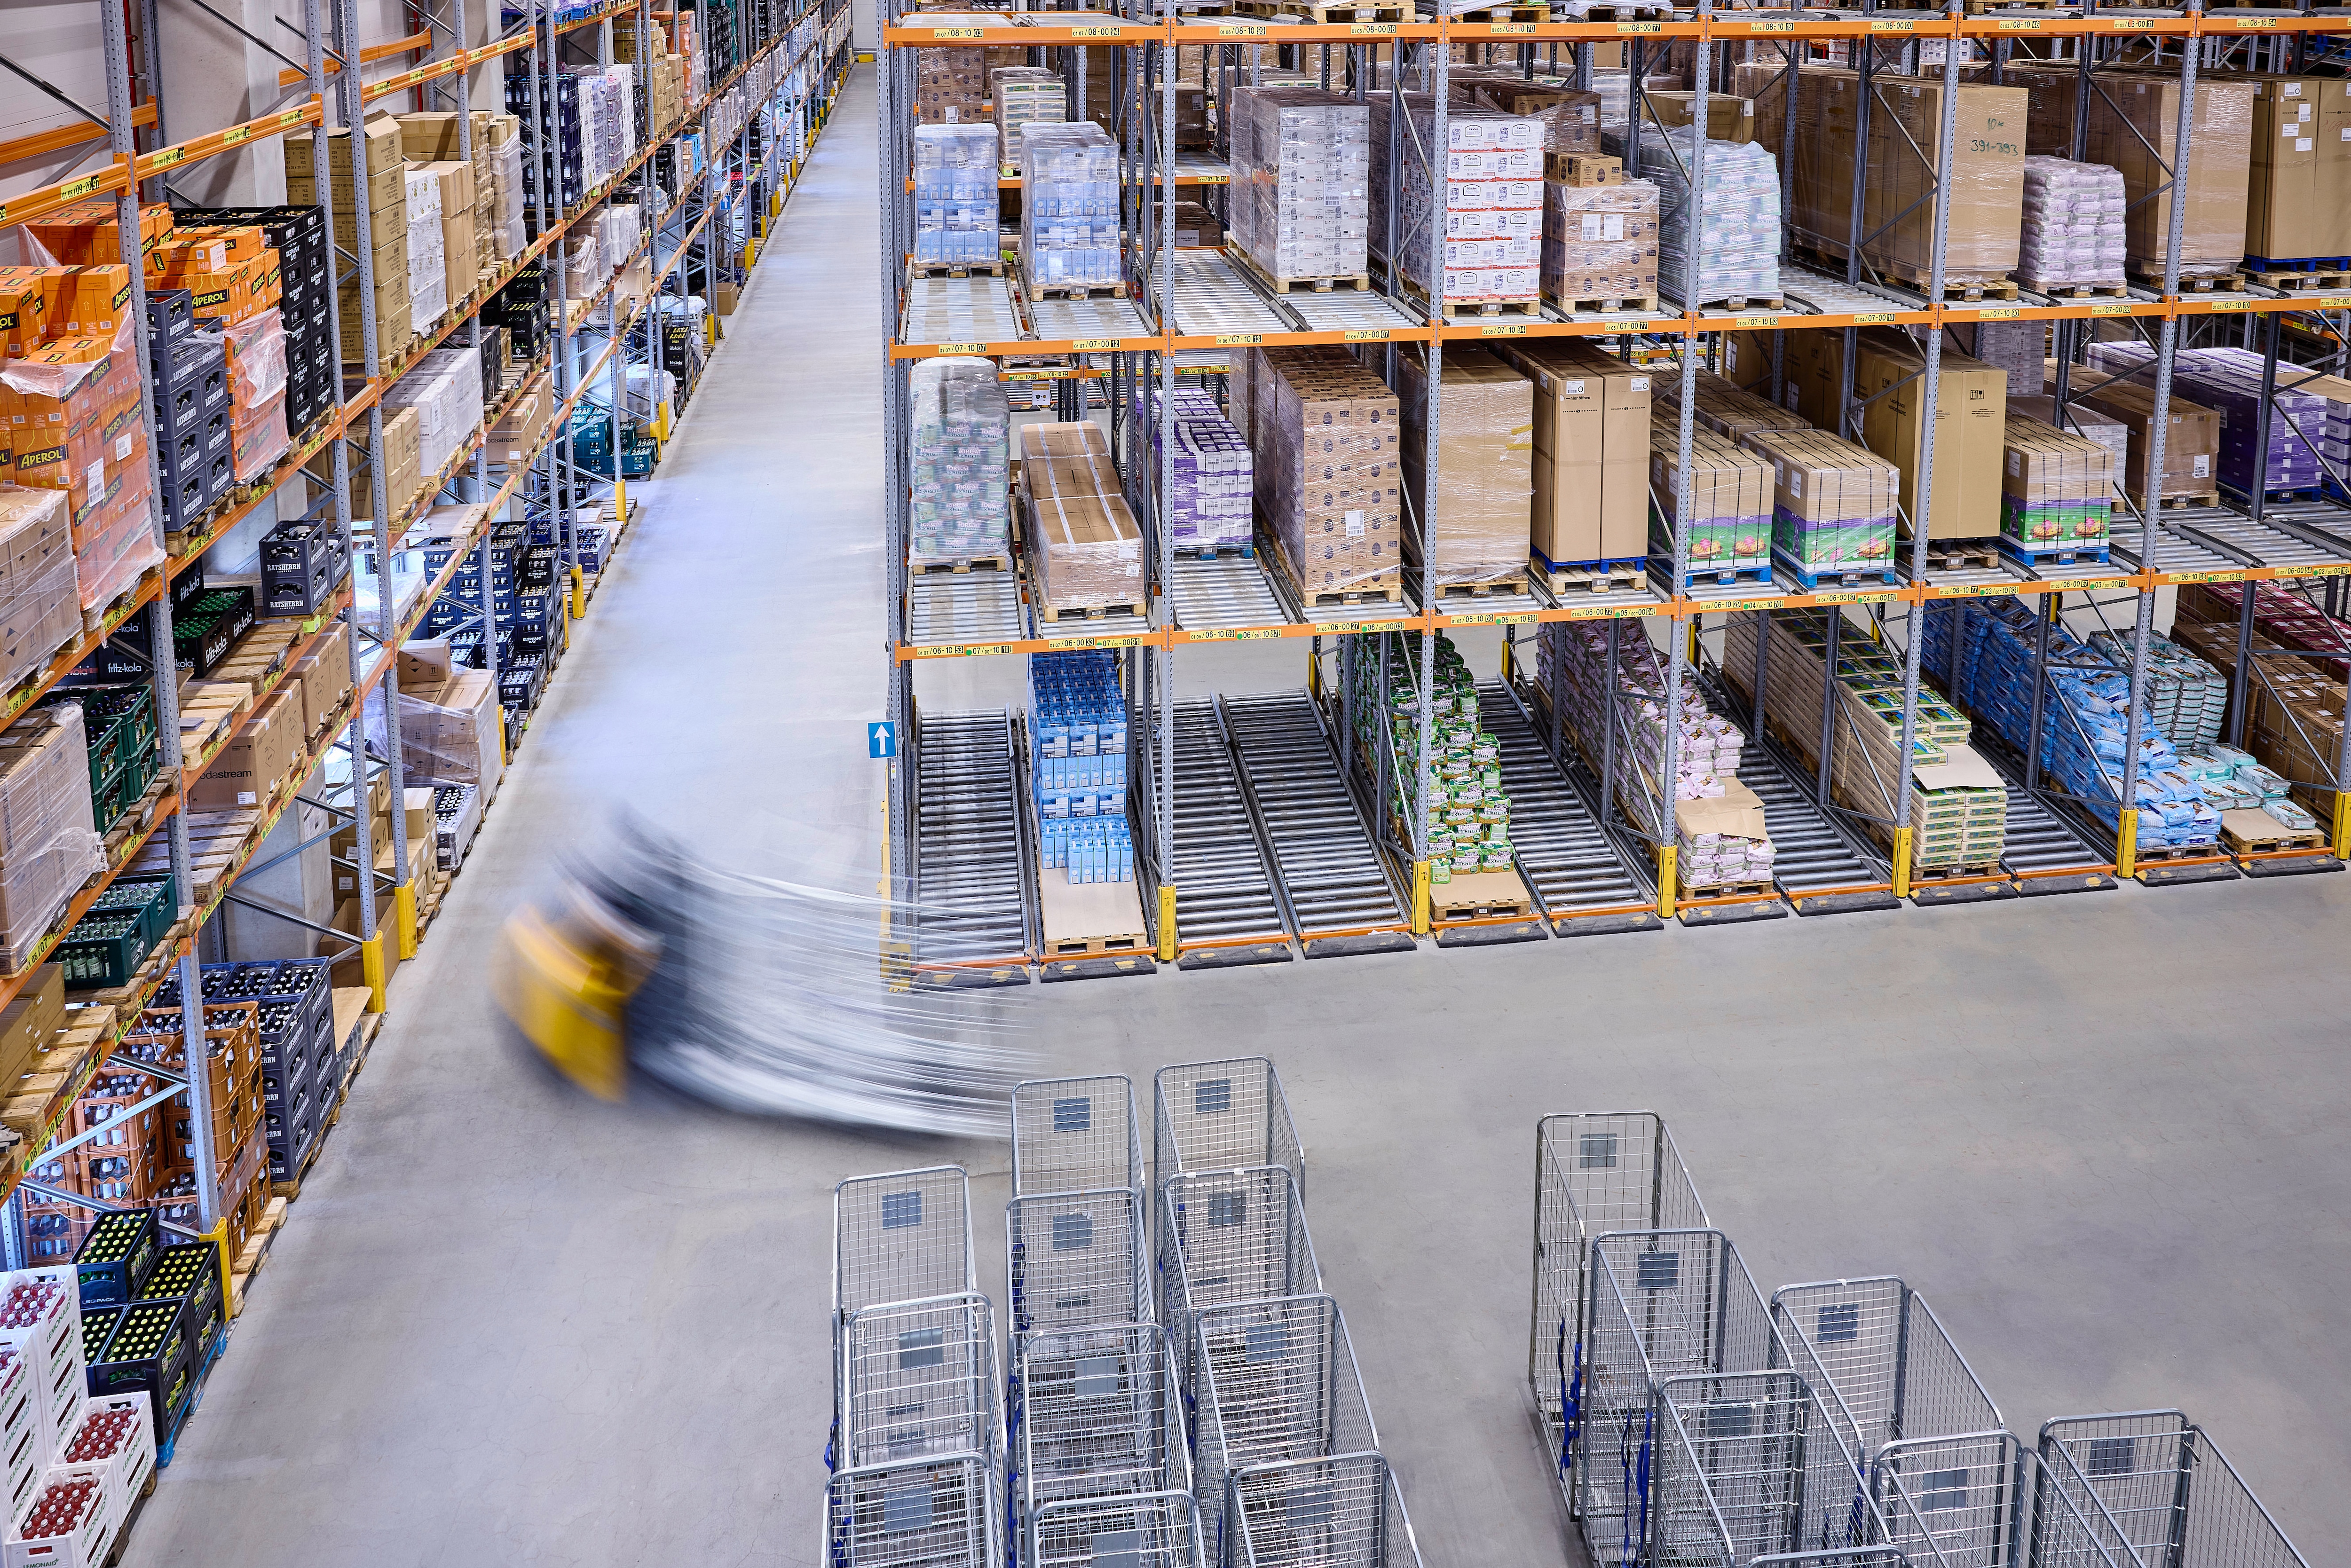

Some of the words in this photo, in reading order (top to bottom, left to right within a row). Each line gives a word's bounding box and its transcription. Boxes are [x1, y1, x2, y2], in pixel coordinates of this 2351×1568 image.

[252, 275, 264, 293] APEROL
[268, 268, 280, 284] APEROL
[192, 292, 225, 307] APEROL
[169, 318, 189, 336] RATSHERRN
[91, 362, 110, 385] APEROL
[205, 387, 223, 407] RATSHERRN
[176, 407, 197, 427] RATSHERRN
[105, 418, 123, 441] APEROL
[21, 450, 62, 468] APEROL
[180, 450, 199, 472] RATSHERRN
[183, 494, 203, 517] RATSHERRN
[267, 563, 301, 571] RATSHERRN
